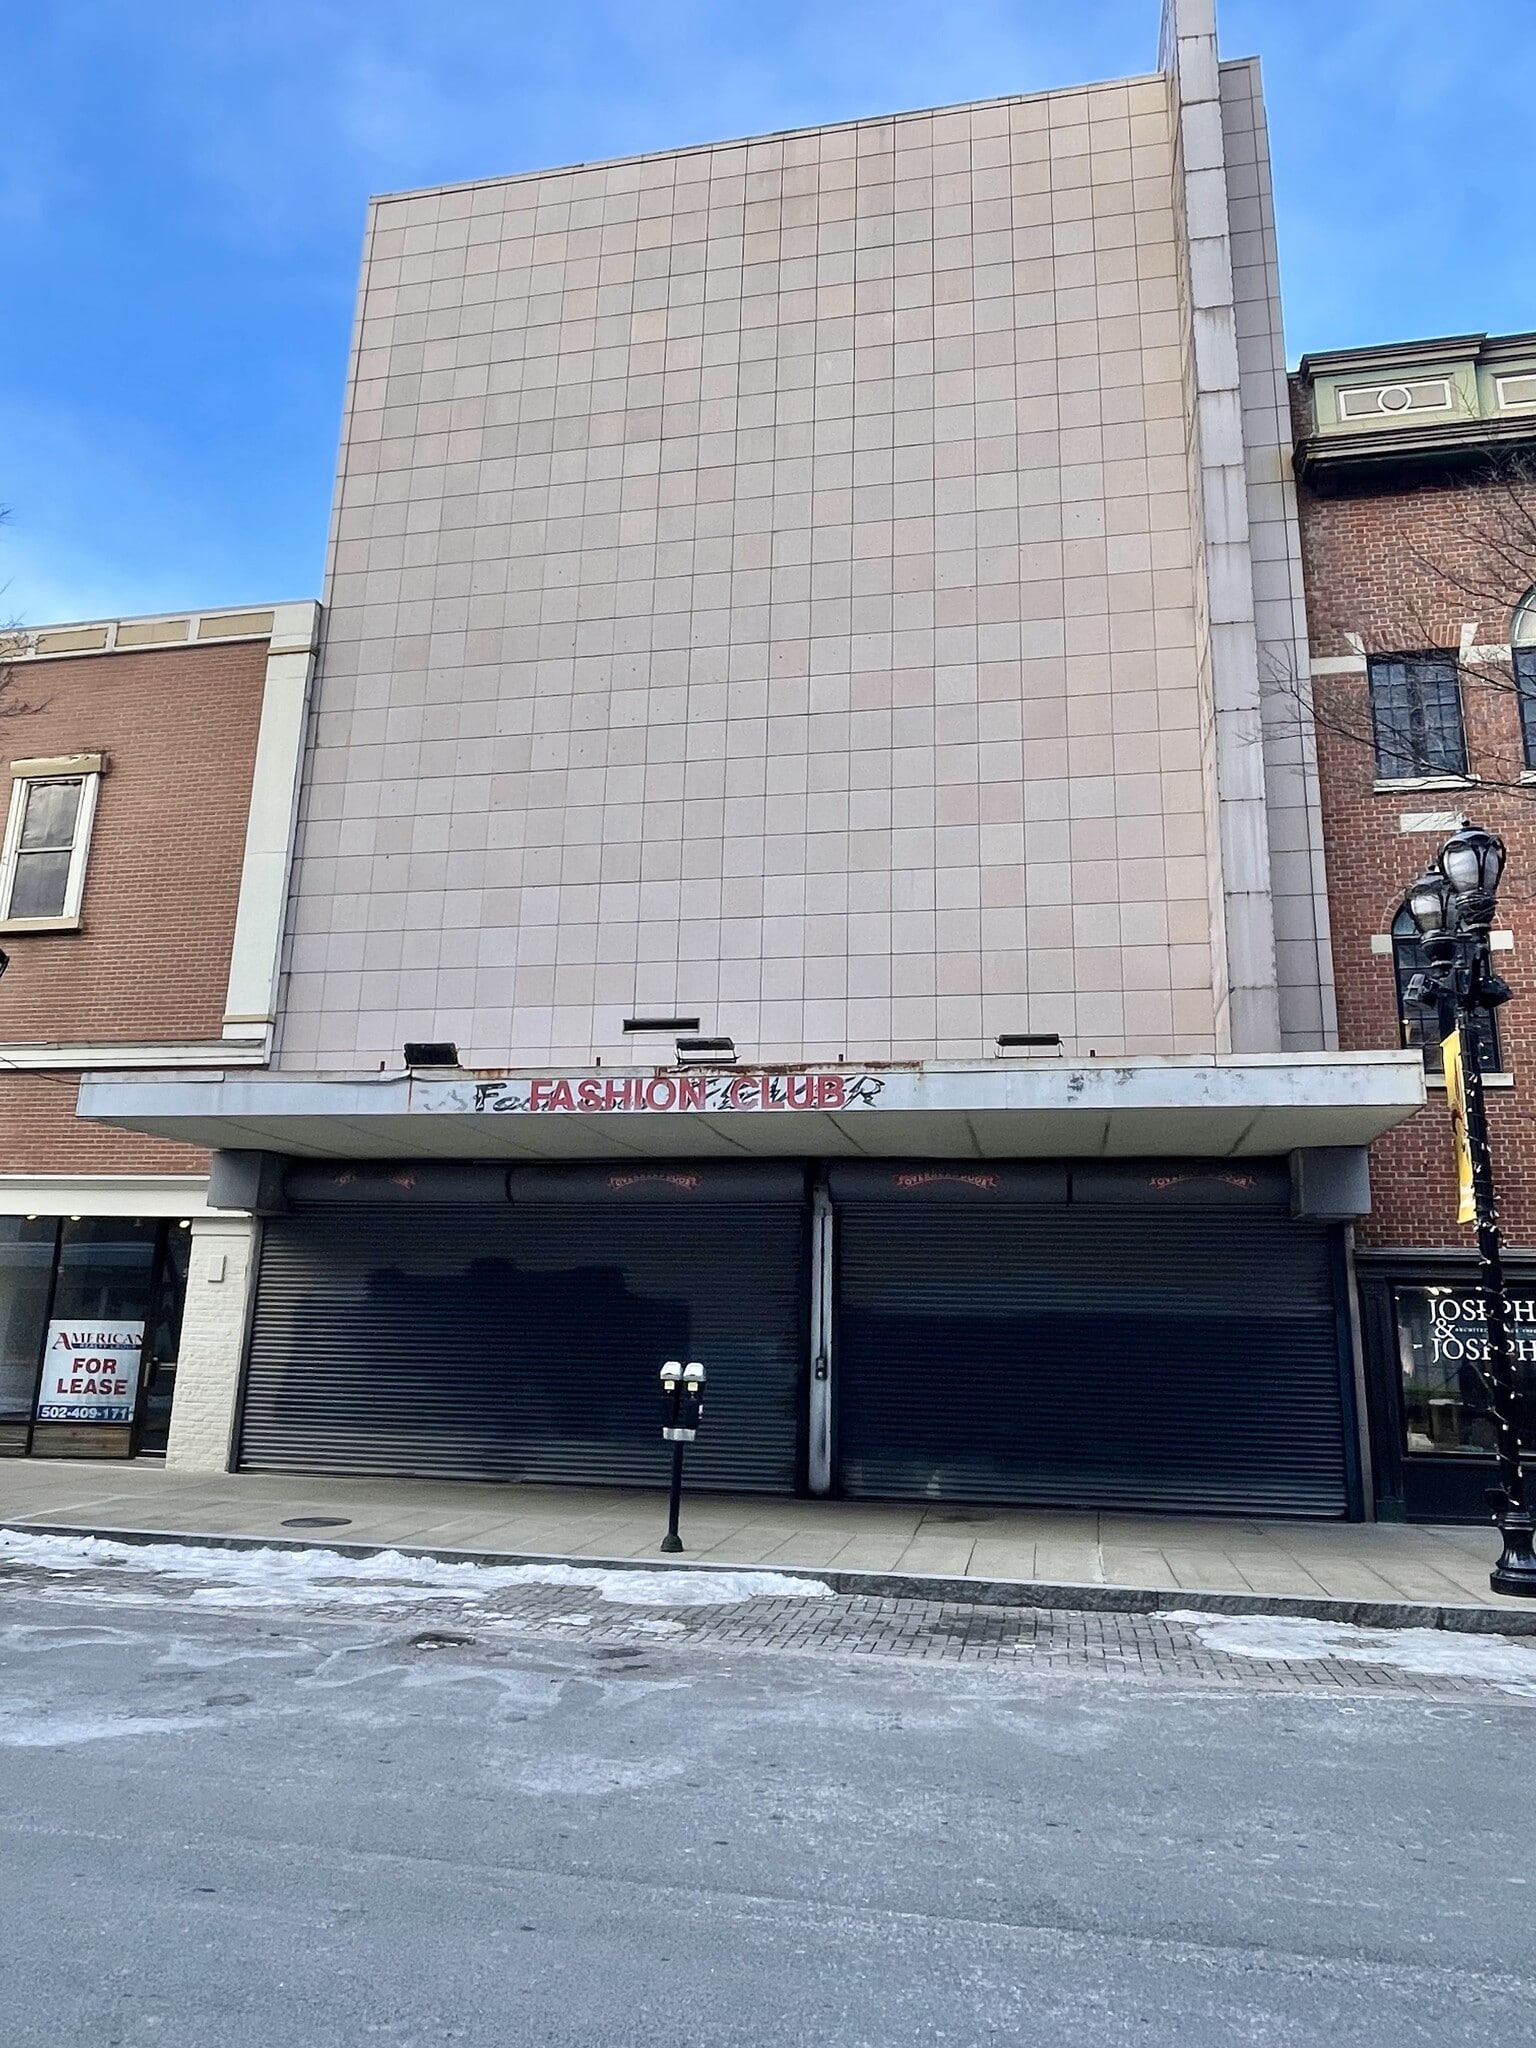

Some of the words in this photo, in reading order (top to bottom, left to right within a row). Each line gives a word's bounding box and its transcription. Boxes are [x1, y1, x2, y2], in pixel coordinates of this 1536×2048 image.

[530, 1077, 706, 1112] FASHION
[730, 1075, 845, 1110] CLUB
[1428, 1299, 1536, 1324] JOSEH
[1434, 1318, 1456, 1339] &
[52, 1332, 143, 1350] AMERICAN
[1431, 1338, 1536, 1363] JOSEH
[72, 1358, 117, 1374] FOR
[57, 1378, 128, 1395] LEASE
[41, 1406, 133, 1420] 502-409-171
